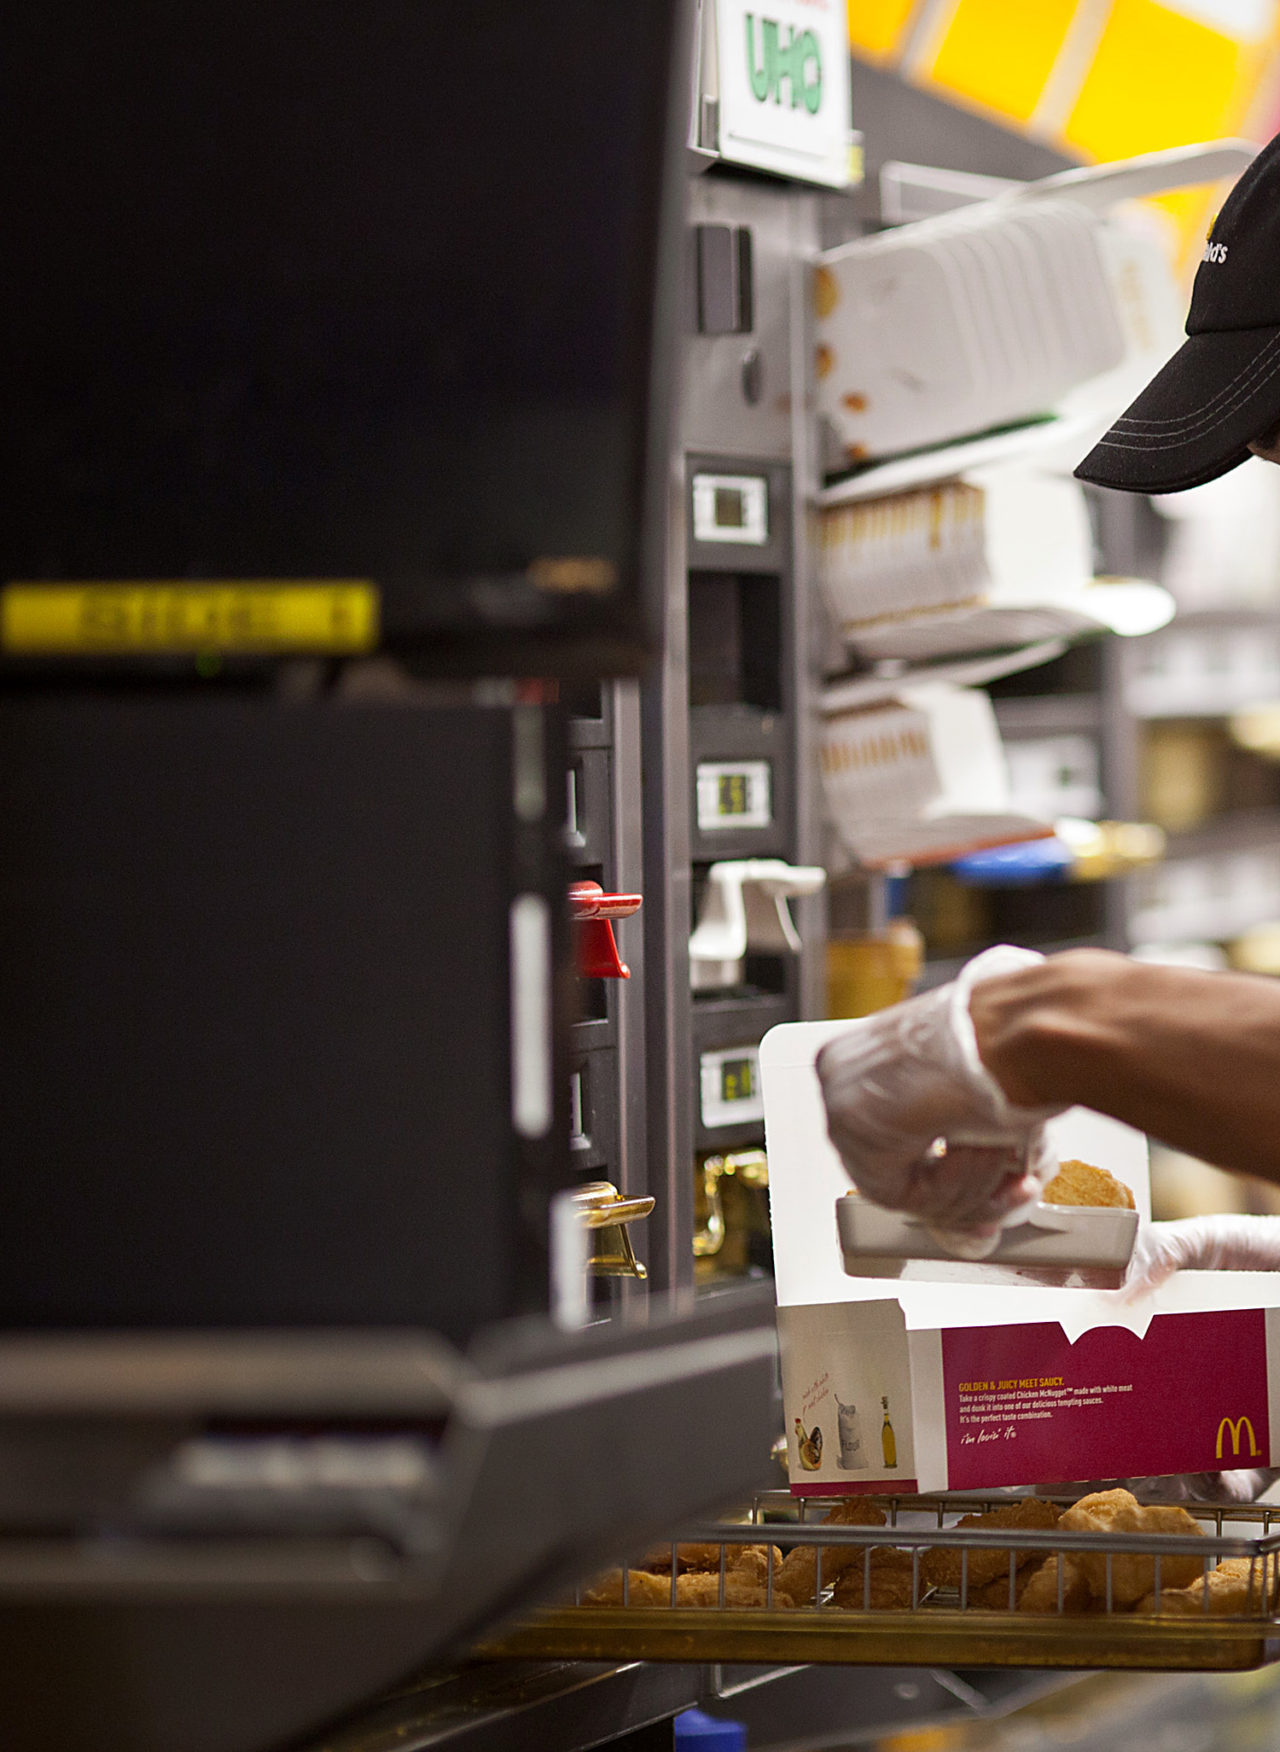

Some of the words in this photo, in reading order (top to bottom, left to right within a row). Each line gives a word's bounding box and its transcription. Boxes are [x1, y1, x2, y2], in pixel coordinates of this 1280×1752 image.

[959, 1381, 989, 1392] GOLDEN
[989, 1381, 996, 1391] &
[998, 1379, 1018, 1390] JUICY
[1019, 1378, 1038, 1388] MEET
[1040, 1376, 1065, 1387] SAUCY.
[959, 1394, 972, 1402] Take
[978, 1394, 996, 1402] crispy
[996, 1392, 1016, 1400] coated
[1016, 1391, 1038, 1399] Chicken
[1073, 1386, 1089, 1395] made
[1089, 1385, 1102, 1394] with
[1102, 1384, 1118, 1393] white
[1118, 1384, 1133, 1392] meat
[959, 1405, 971, 1413] and
[971, 1404, 985, 1412] dunk
[986, 1403, 991, 1412] it
[992, 1403, 1003, 1411] into
[1015, 1401, 1021, 1410] of
[1032, 1400, 1057, 1409] delicious
[1057, 1398, 1082, 1407] tempting
[1082, 1397, 1104, 1405] sauces.
[959, 1415, 970, 1423] It's
[970, 1414, 980, 1423] the
[980, 1413, 1001, 1424] perfect
[1002, 1413, 1016, 1421] taste
[1017, 1410, 1054, 1420] combination.
